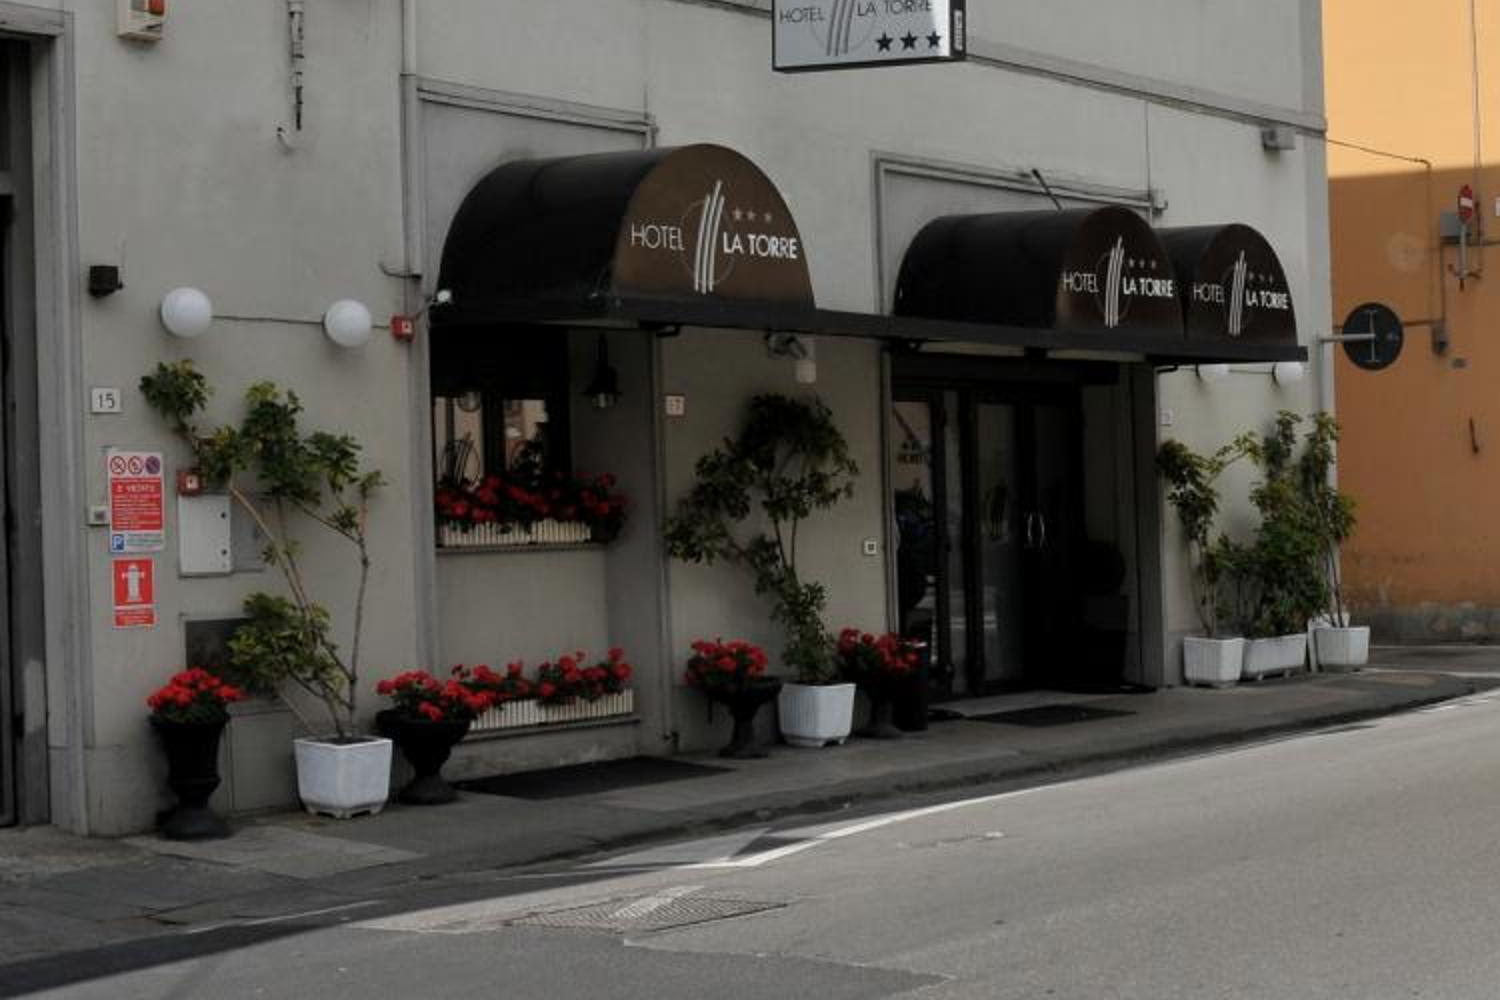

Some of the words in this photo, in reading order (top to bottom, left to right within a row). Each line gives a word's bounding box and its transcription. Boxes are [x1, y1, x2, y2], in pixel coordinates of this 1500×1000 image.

[779, 6, 825, 24] HOTEL
[857, 1, 878, 17] LA
[631, 222, 685, 250] HOTEL
[723, 232, 744, 254] LA
[748, 233, 797, 260] TORRE
[1062, 271, 1099, 293] HOTEL
[1123, 277, 1137, 295] LA
[1139, 278, 1173, 297] TORRE
[1193, 282, 1225, 303] HOTEL
[1245, 289, 1258, 307] LA
[1260, 291, 1289, 310] TORRE
[99, 394, 115, 410] 15
[113, 536, 122, 548] P
